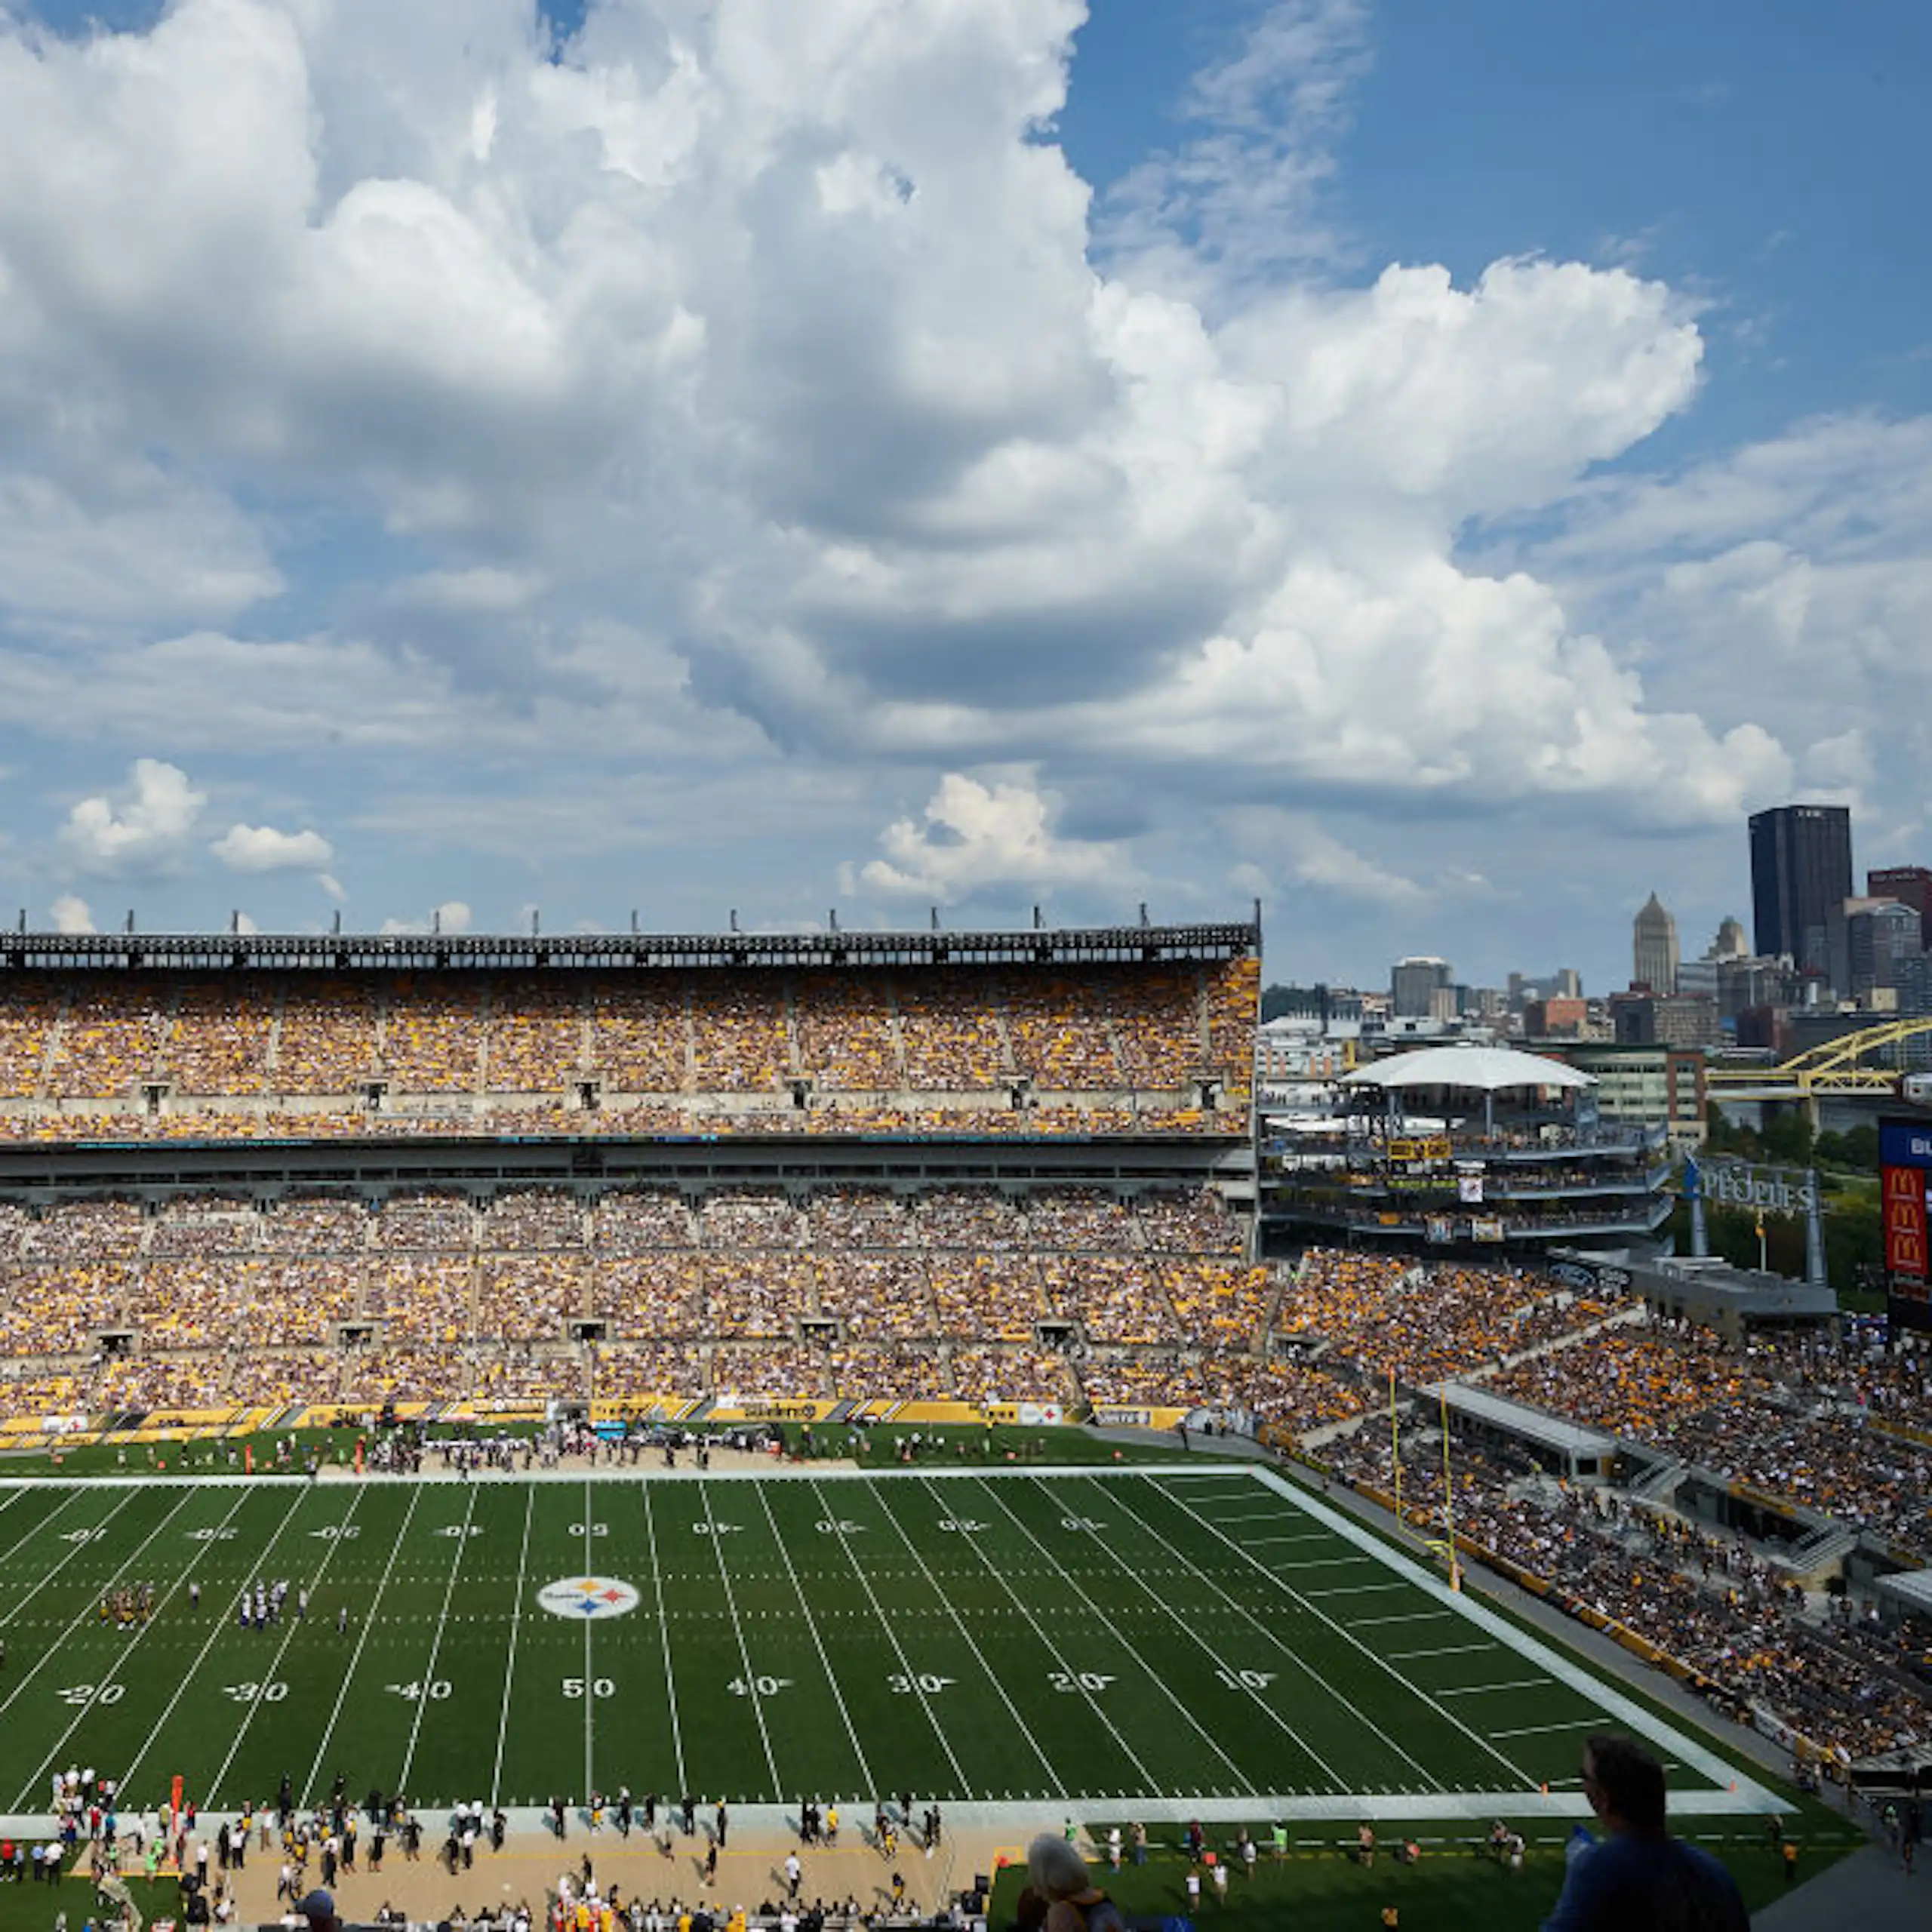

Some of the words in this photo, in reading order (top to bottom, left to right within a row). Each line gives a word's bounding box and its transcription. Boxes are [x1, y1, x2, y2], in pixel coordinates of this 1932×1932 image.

[562, 1677, 615, 1698] 50
[727, 1675, 778, 1696] 40
[887, 1673, 942, 1693] 30
[1047, 1672, 1106, 1692] 20
[1214, 1669, 1268, 1690] 10
[65, 1684, 126, 1704] 20
[232, 1682, 288, 1701] 30
[399, 1681, 452, 1700] 40
